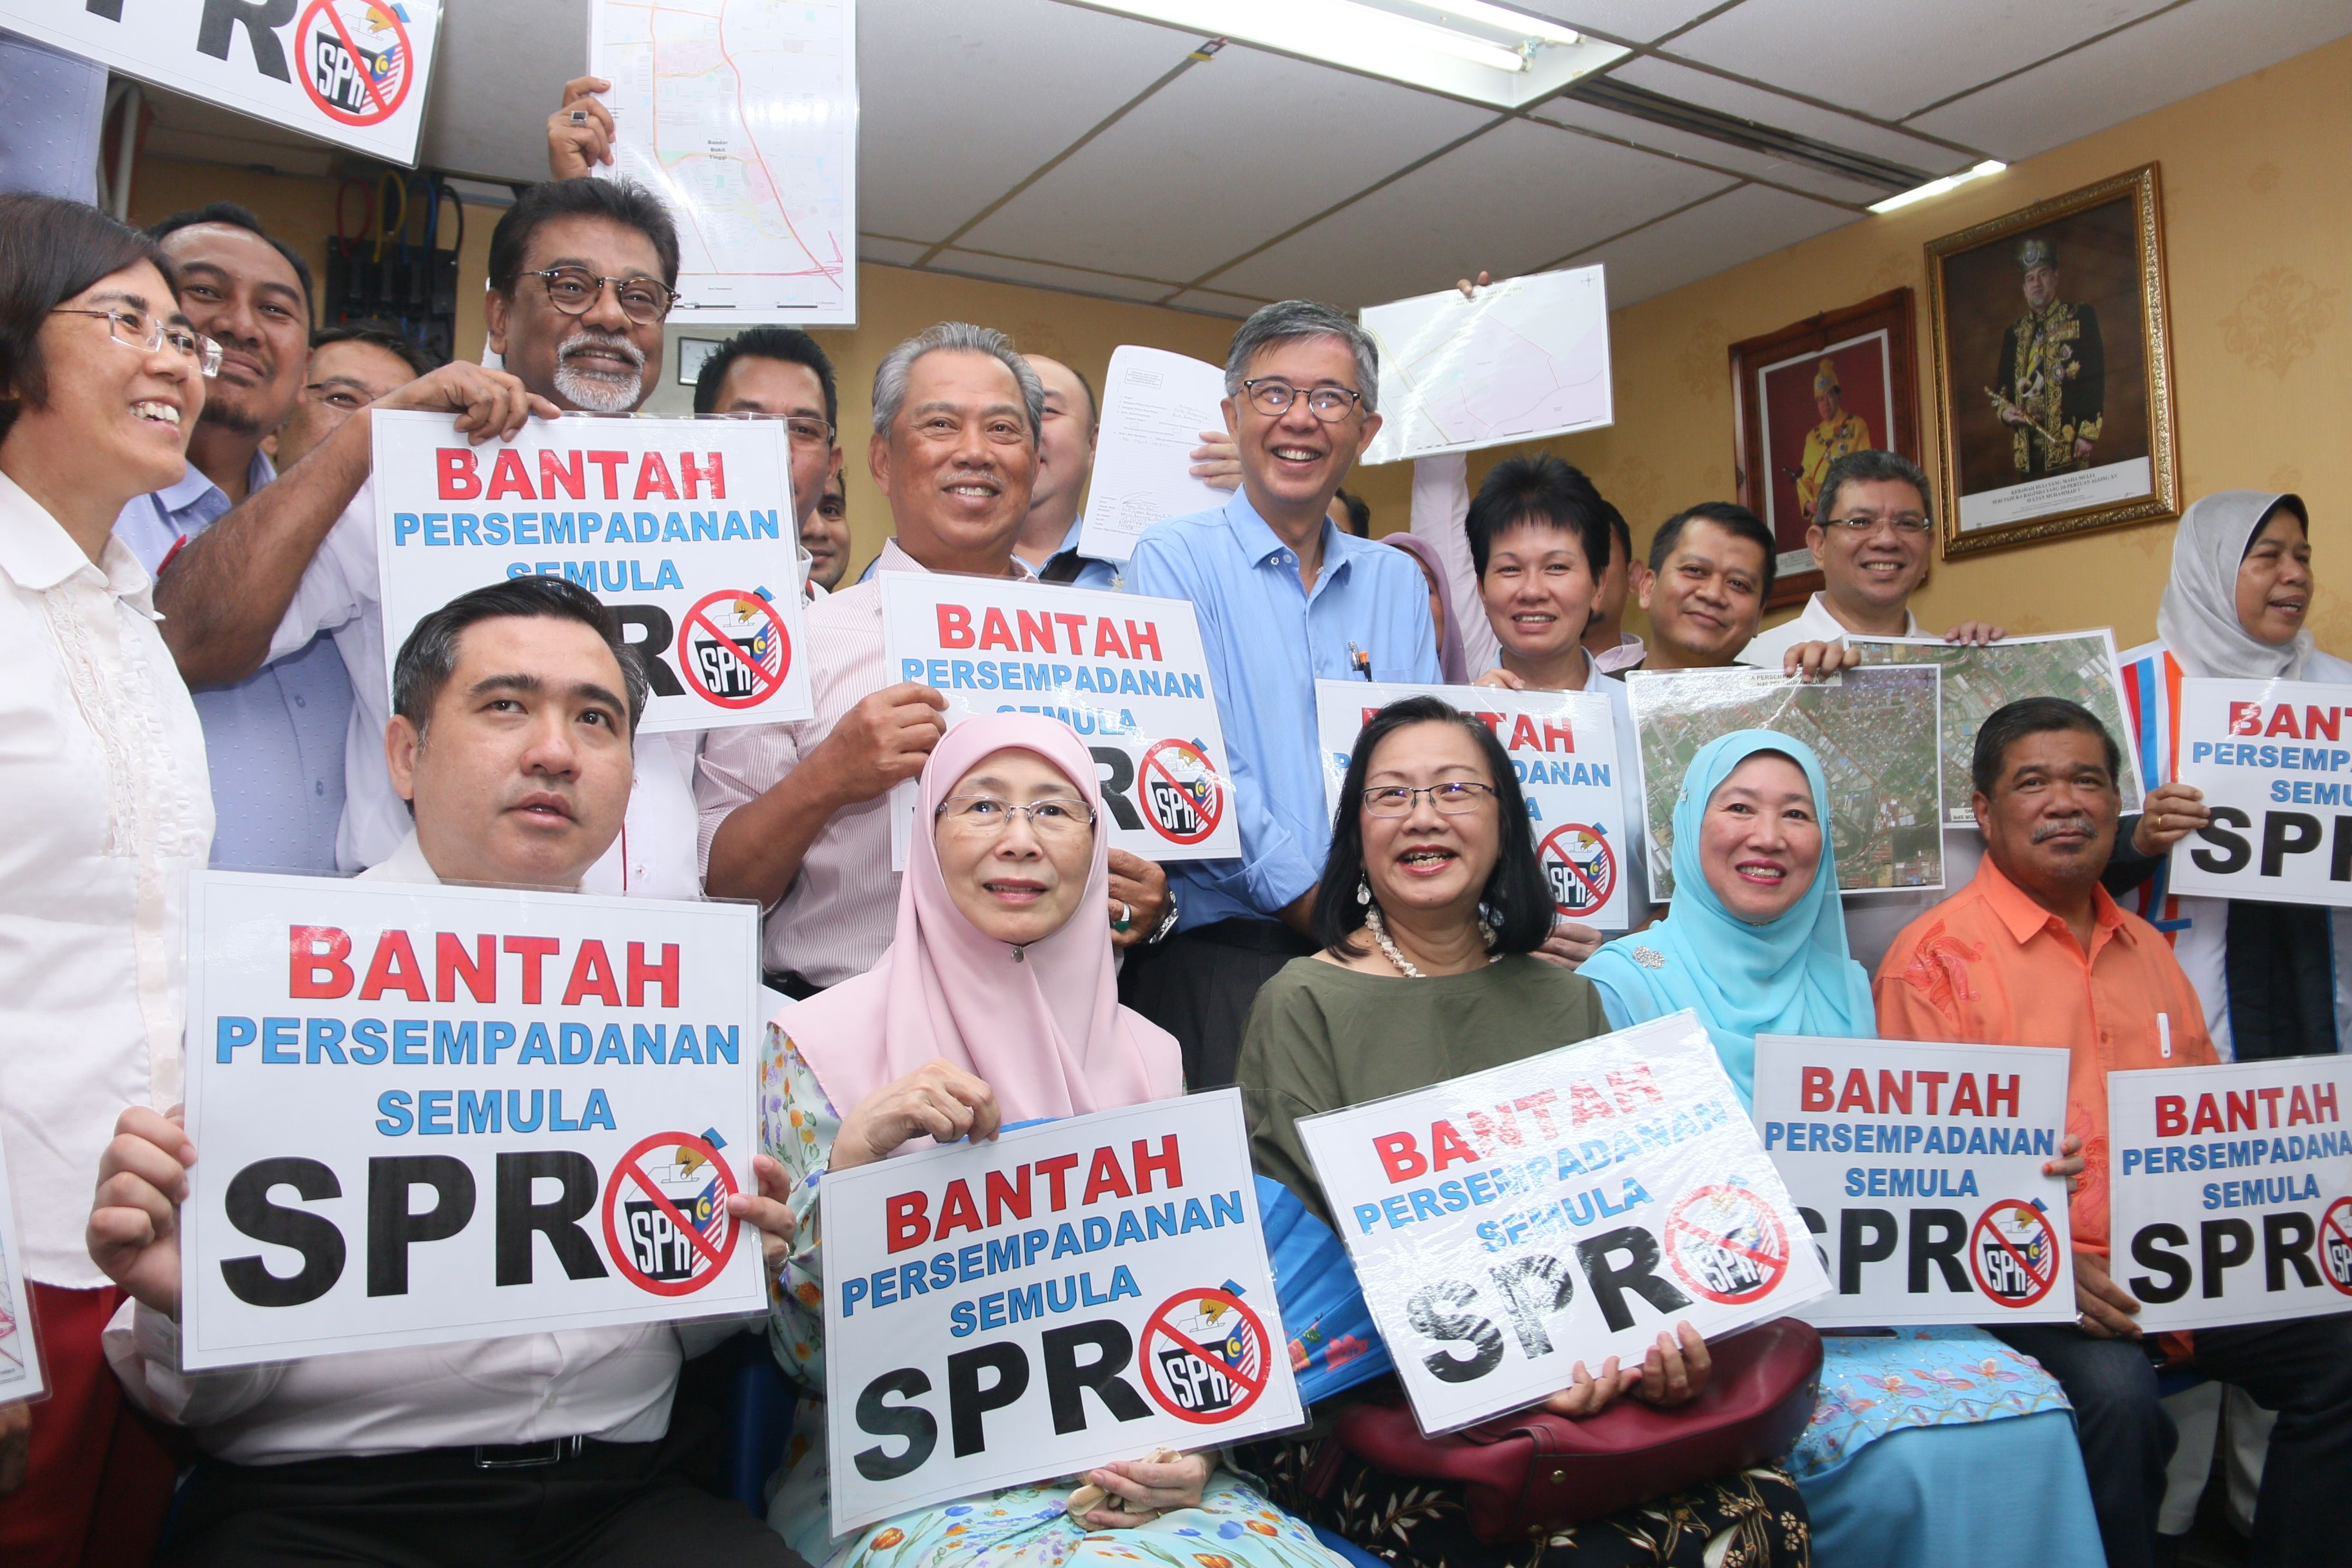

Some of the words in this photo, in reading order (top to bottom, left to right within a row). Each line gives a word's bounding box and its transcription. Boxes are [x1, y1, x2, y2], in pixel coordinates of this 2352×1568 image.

[436, 447, 726, 500] BANTAH
[393, 509, 779, 546] PERSEMPADANAN
[936, 603, 1163, 662] BANTAH
[901, 658, 1205, 700] PERSEMPADANAN
[2229, 701, 2352, 741] BAN
[2193, 741, 2352, 772] PERSEMP
[2190, 805, 2352, 882] SP
[289, 924, 680, 1008] BANTAH
[215, 1015, 740, 1065] PERSEMPADANAN
[375, 1088, 617, 1137] SEMULA
[1800, 1066, 2021, 1118] BANTAH
[2155, 1082, 2340, 1137] BANTAH
[1371, 1061, 1663, 1184] BANTAH
[1764, 1121, 2055, 1156] PERSEMPADANAN
[885, 1133, 1184, 1255] BANTAH
[1352, 1098, 1731, 1236] PERSEMPADANAN
[1845, 1167, 1979, 1197] SEMULA
[2202, 1173, 2321, 1210] SEMULA
[219, 1150, 610, 1308] SPR
[1475, 1176, 1654, 1253] SEMULA
[841, 1190, 1245, 1318] PERSEMPADANAN
[2128, 1211, 2324, 1304] SPR
[950, 1264, 1142, 1338] SEMULA
[1406, 1225, 1694, 1384] SPR
[854, 1318, 1155, 1482] SPR
